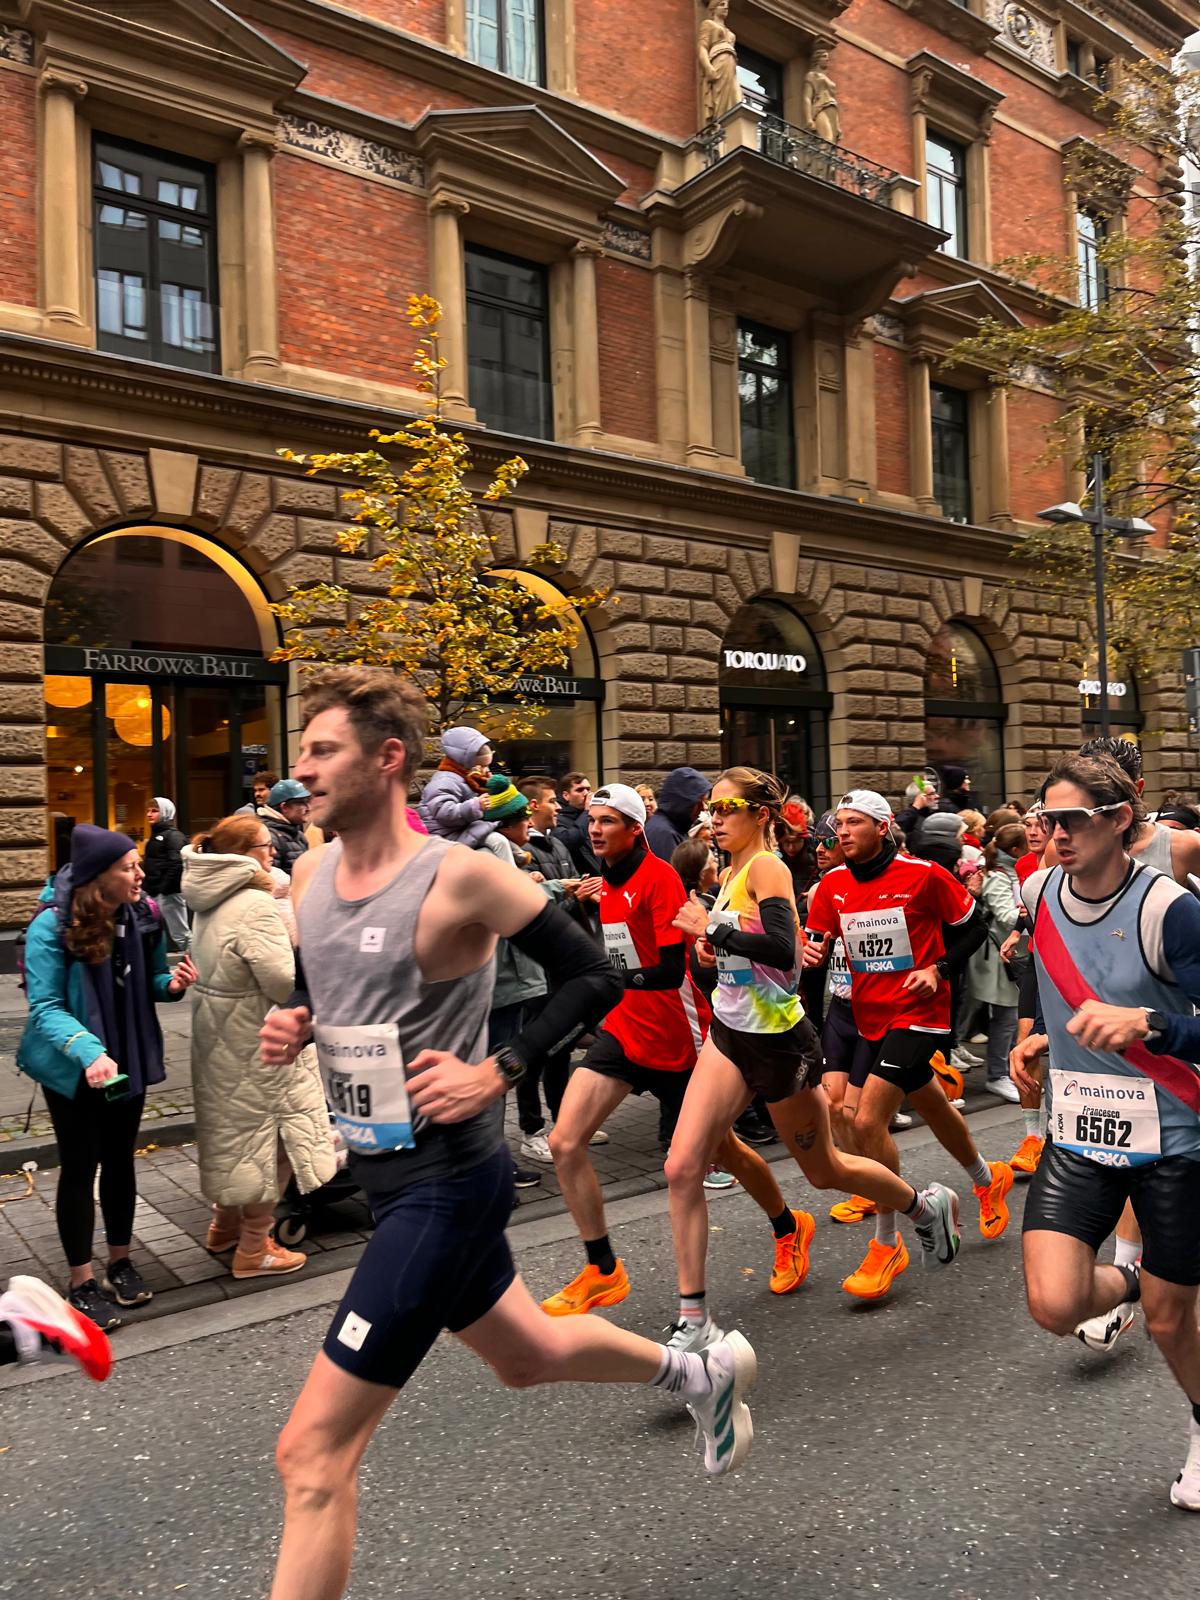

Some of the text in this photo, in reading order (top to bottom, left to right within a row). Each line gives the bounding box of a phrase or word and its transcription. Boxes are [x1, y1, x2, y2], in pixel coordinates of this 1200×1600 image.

[723, 650, 807, 672] TORQUATO
[857, 917, 899, 929] mainova
[858, 938, 894, 957] 4322
[865, 960, 895, 972] HOKA
[1079, 1085, 1145, 1100] mainova
[1082, 1106, 1120, 1119] Francesco
[1076, 1115, 1132, 1148] 6562
